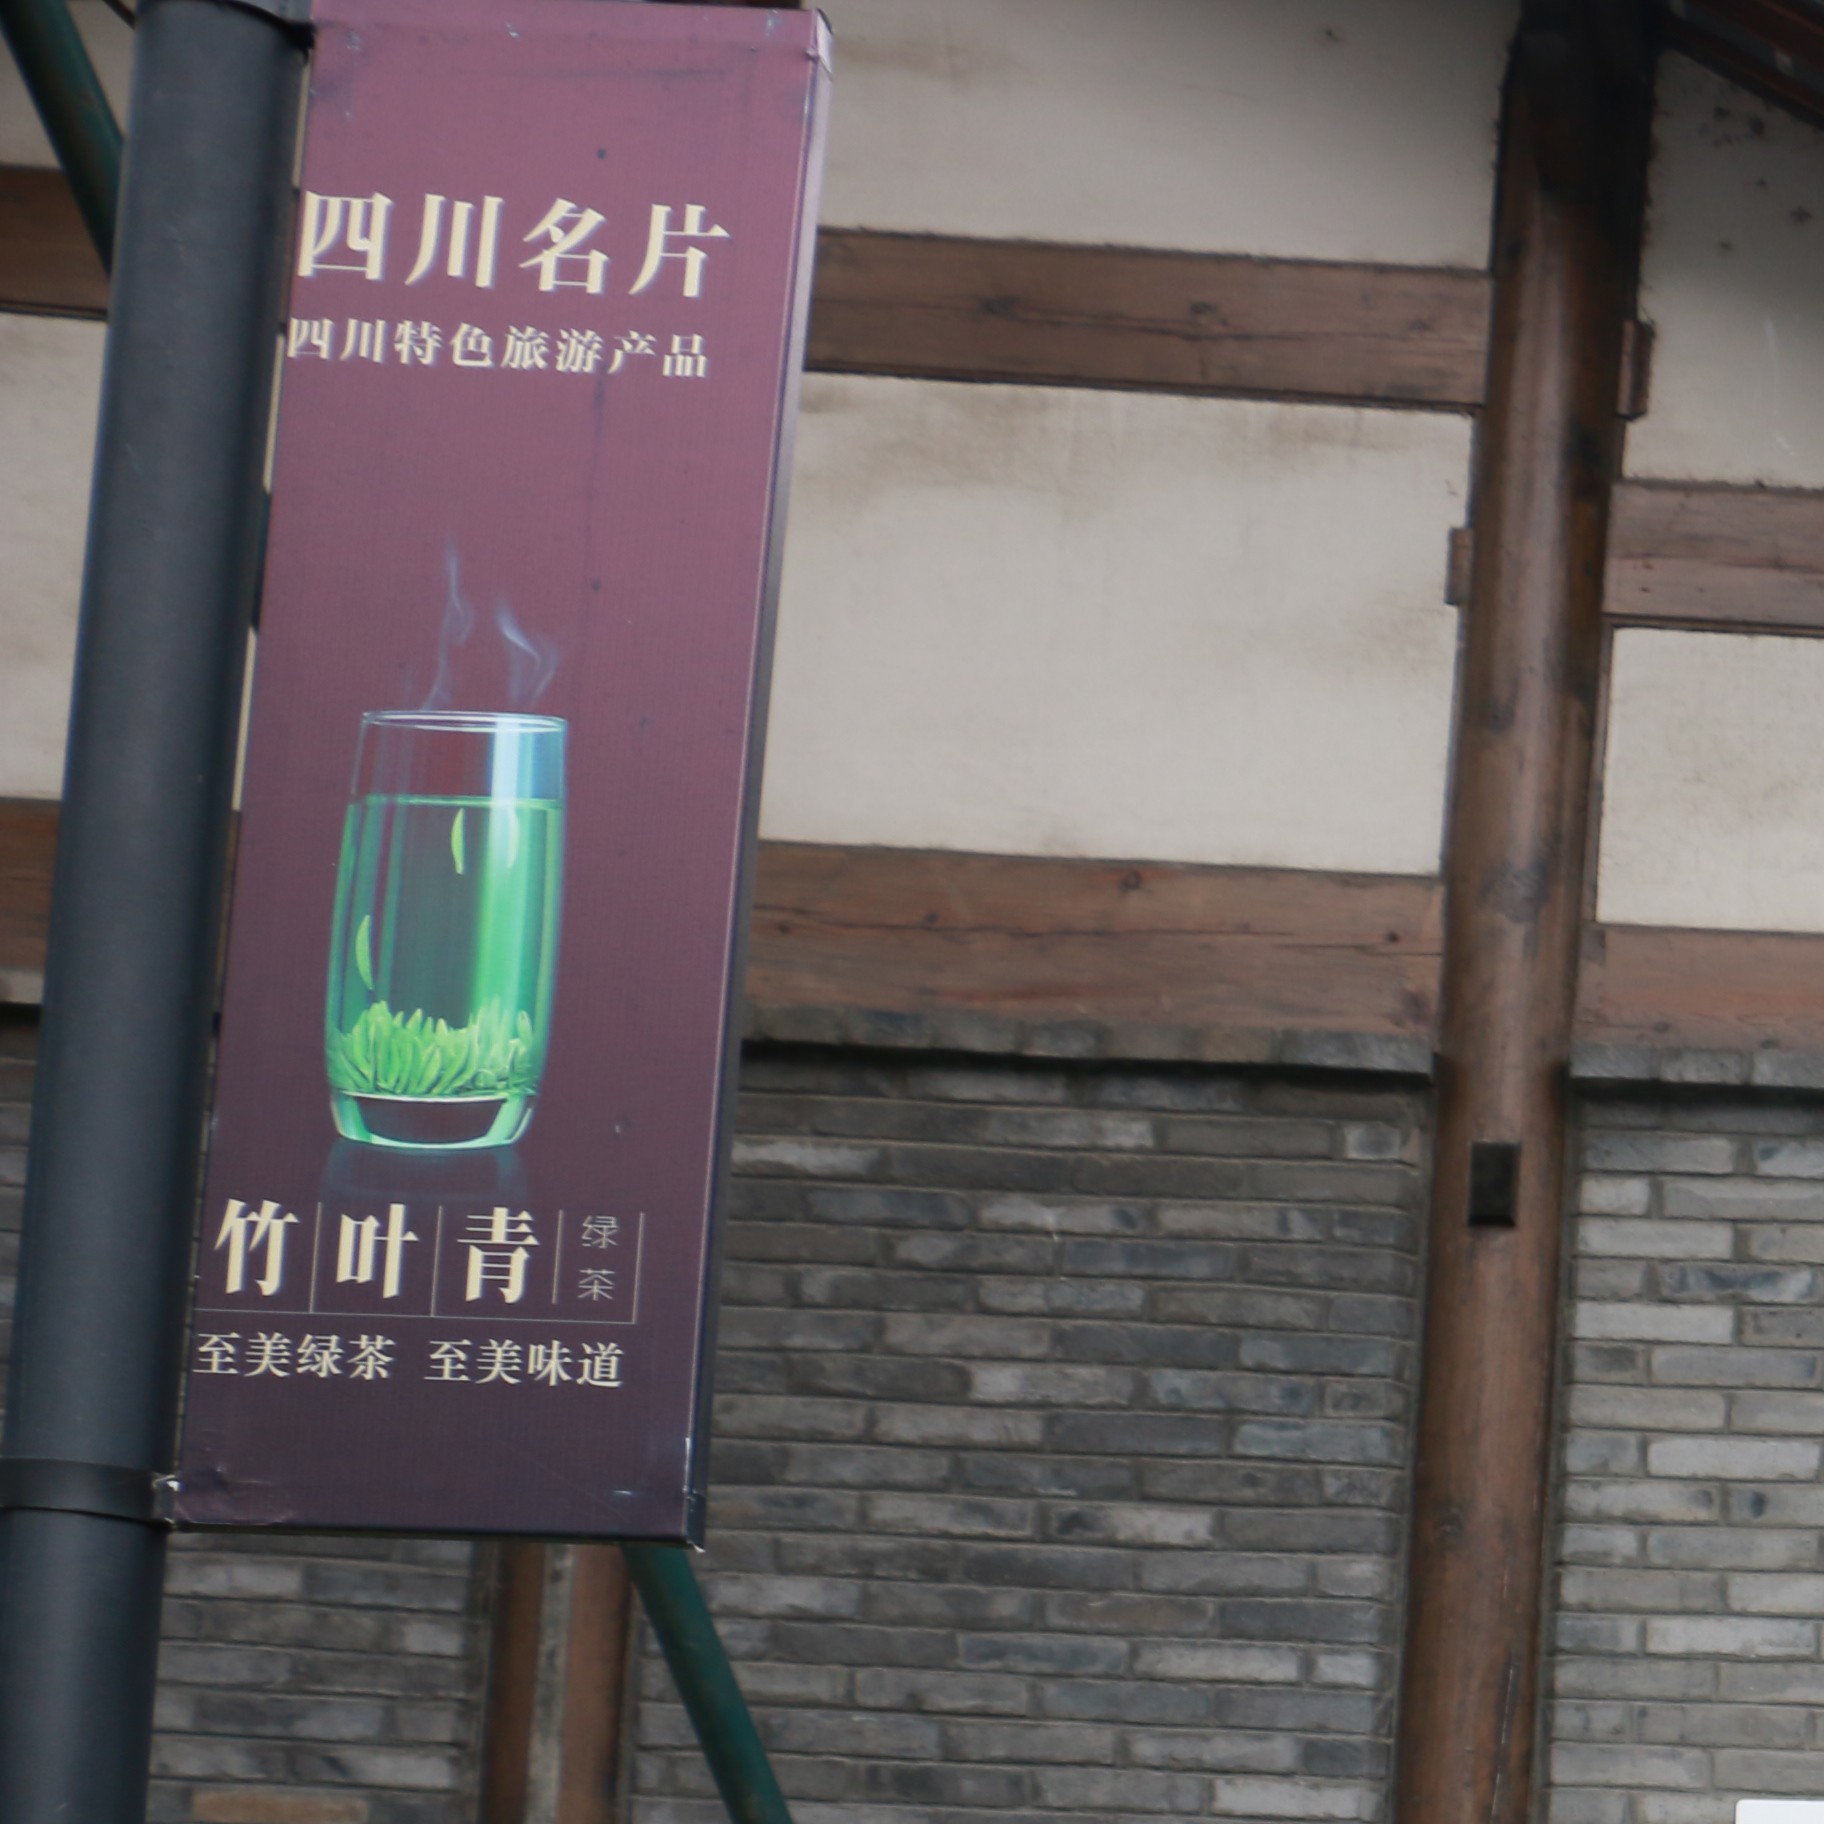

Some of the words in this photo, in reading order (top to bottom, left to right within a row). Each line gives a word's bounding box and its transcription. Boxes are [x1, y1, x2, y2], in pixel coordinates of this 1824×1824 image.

[298, 191, 730, 297] 四川名片
[287, 317, 708, 378] 四川特色旅游产品
[214, 1198, 540, 1303] 竹叶青
[577, 1215, 619, 1301] 绿茶
[193, 1332, 395, 1380] 至美绿茶
[424, 1339, 624, 1388] 至美味道
